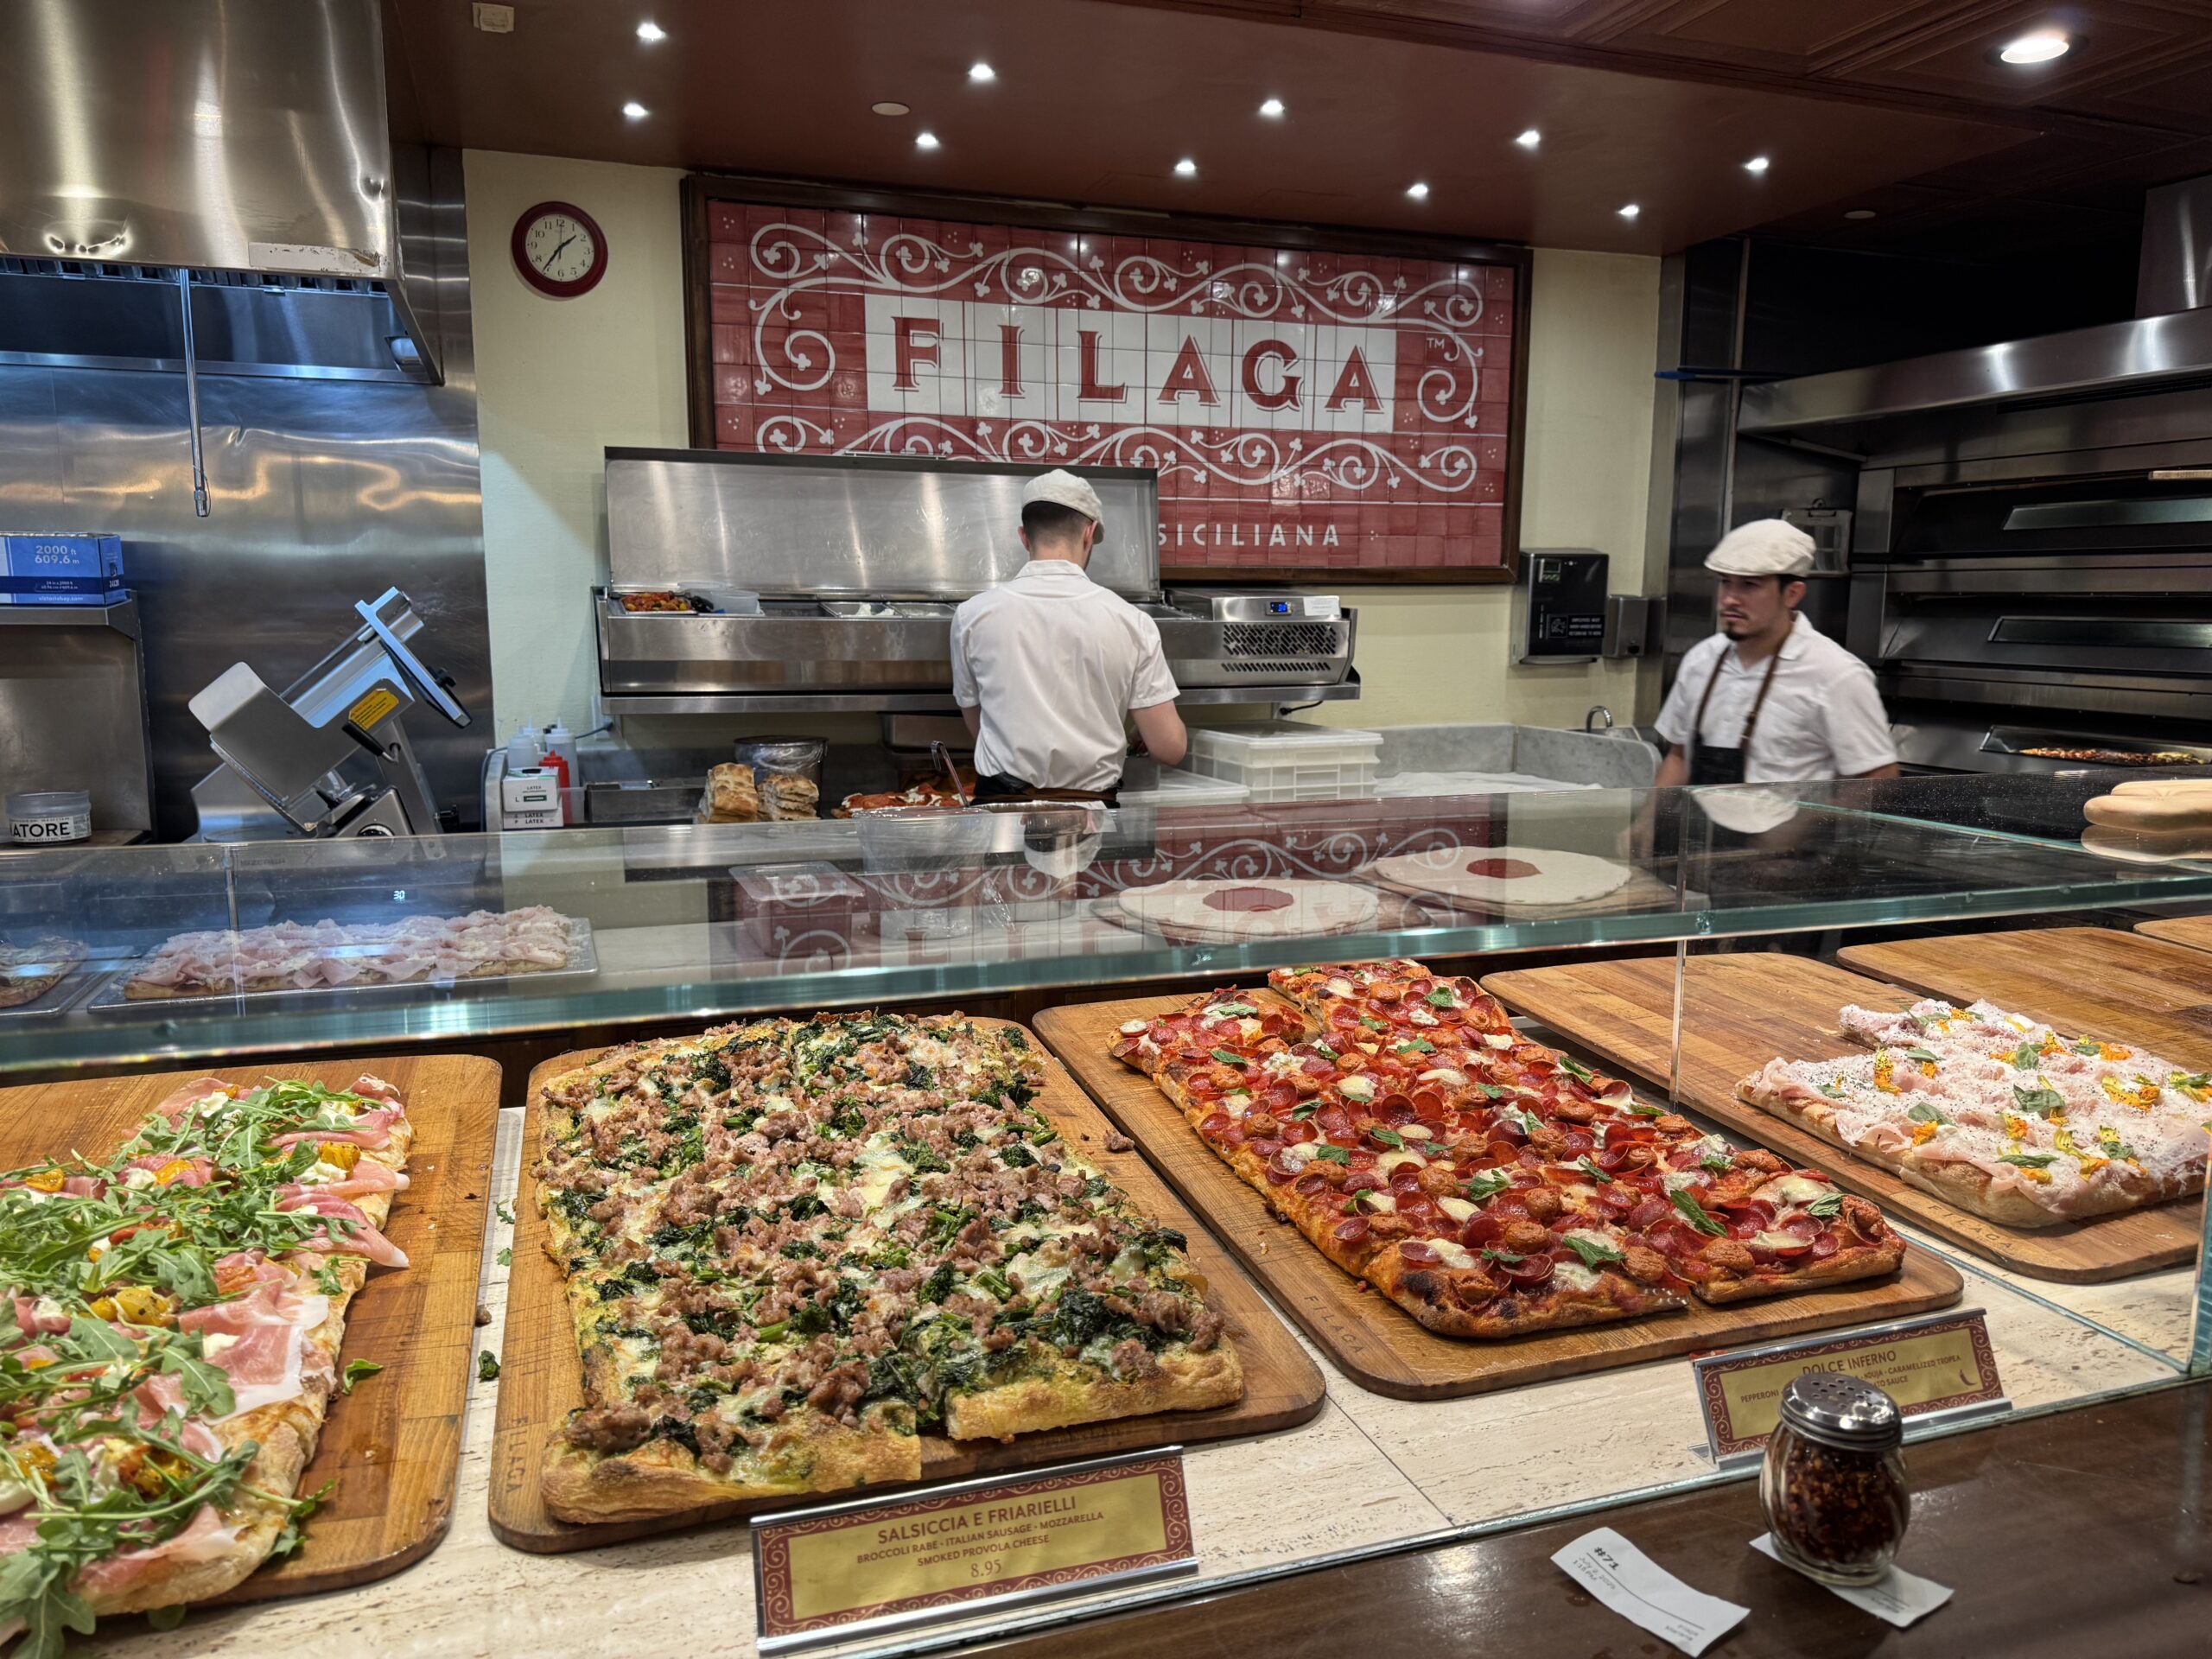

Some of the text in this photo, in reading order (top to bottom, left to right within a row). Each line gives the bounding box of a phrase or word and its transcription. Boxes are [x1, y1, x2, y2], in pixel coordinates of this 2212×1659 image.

[546, 263, 551, 272] 7
[557, 269, 564, 277] 6
[570, 267, 576, 276] 5
[893, 316, 1384, 413] FILAGA
[1158, 523, 1338, 546] SICILIANA
[35, 545, 67, 554] 2000
[35, 555, 70, 564] 609.6
[10, 822, 70, 837] ATORE
[1802, 1351, 1897, 1375] DOLCE INFERNO
[1740, 1389, 1779, 1403] PEPPERONI
[1887, 1360, 1936, 1374] CARAMELIZED
[1936, 1354, 1961, 1365] TROPEA
[1886, 1375, 1909, 1386] SAUCE
[877, 1496, 1077, 1544] SALSICCIA E FRIARIELLI
[857, 1512, 1104, 1564] BROCCOLI RABE ITALIAN SAUSAGE MOZZARELLA
[918, 1535, 1050, 1567] SMOKED PROVOLA CHEESE
[1594, 1546, 1619, 1571] #71
[970, 1559, 1002, 1578] 8.95
